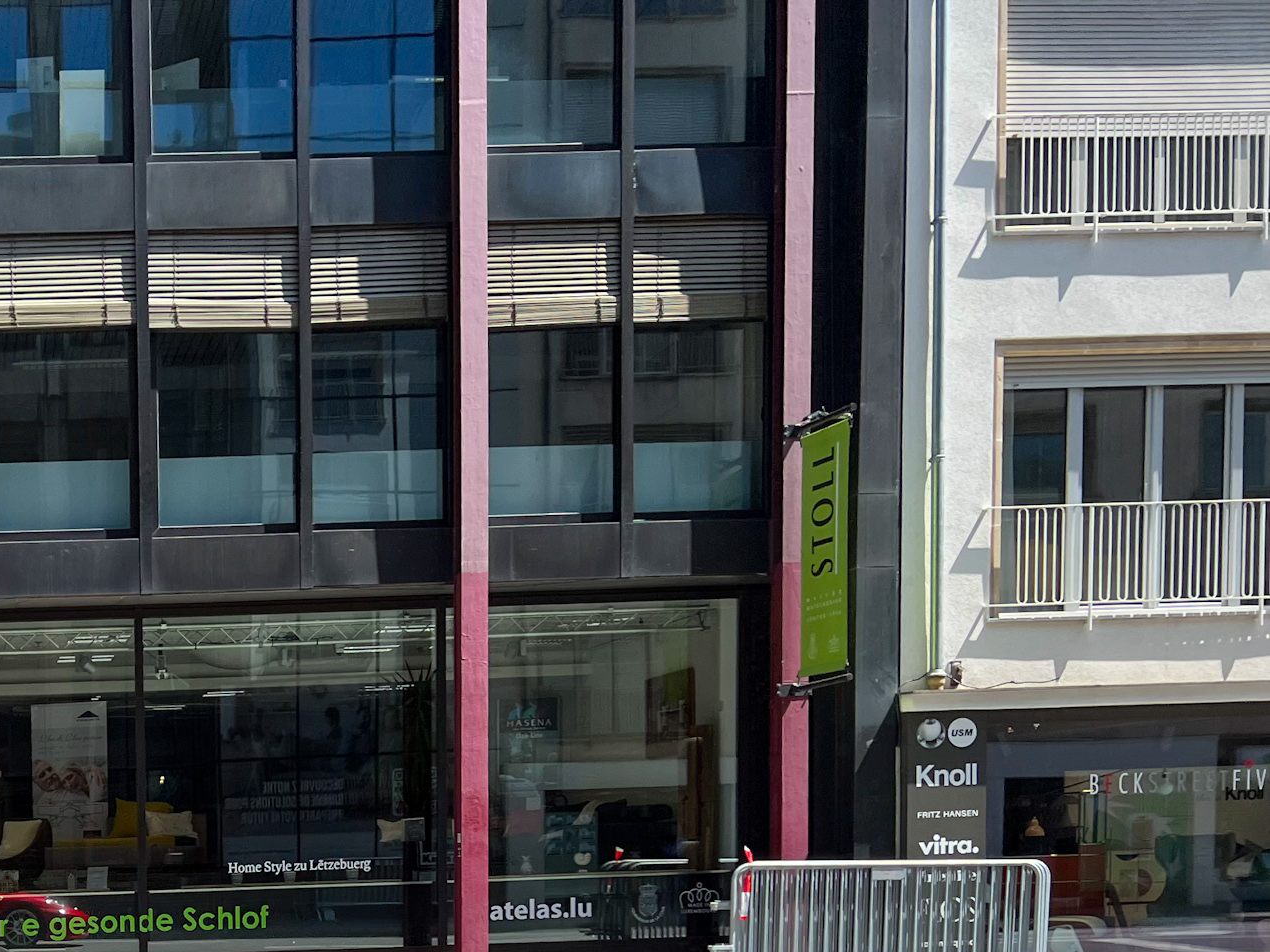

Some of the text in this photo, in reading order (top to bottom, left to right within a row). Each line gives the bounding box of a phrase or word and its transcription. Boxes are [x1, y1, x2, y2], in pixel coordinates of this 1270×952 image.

[811, 446, 834, 577] STOLL
[506, 718, 552, 727] HASENA
[951, 728, 973, 737] USM
[915, 763, 978, 788] Knoll
[1225, 786, 1265, 800] Knoll
[917, 809, 979, 819] FRITZ HANSEN
[918, 834, 979, 855] vitra.
[228, 862, 262, 874] Home
[263, 860, 292, 875] Style
[293, 862, 307, 871] zu
[490, 896, 593, 921] atelas.lu
[22, 918, 40, 937] e
[49, 908, 174, 941] gesonde
[183, 904, 270, 931] Schlof
